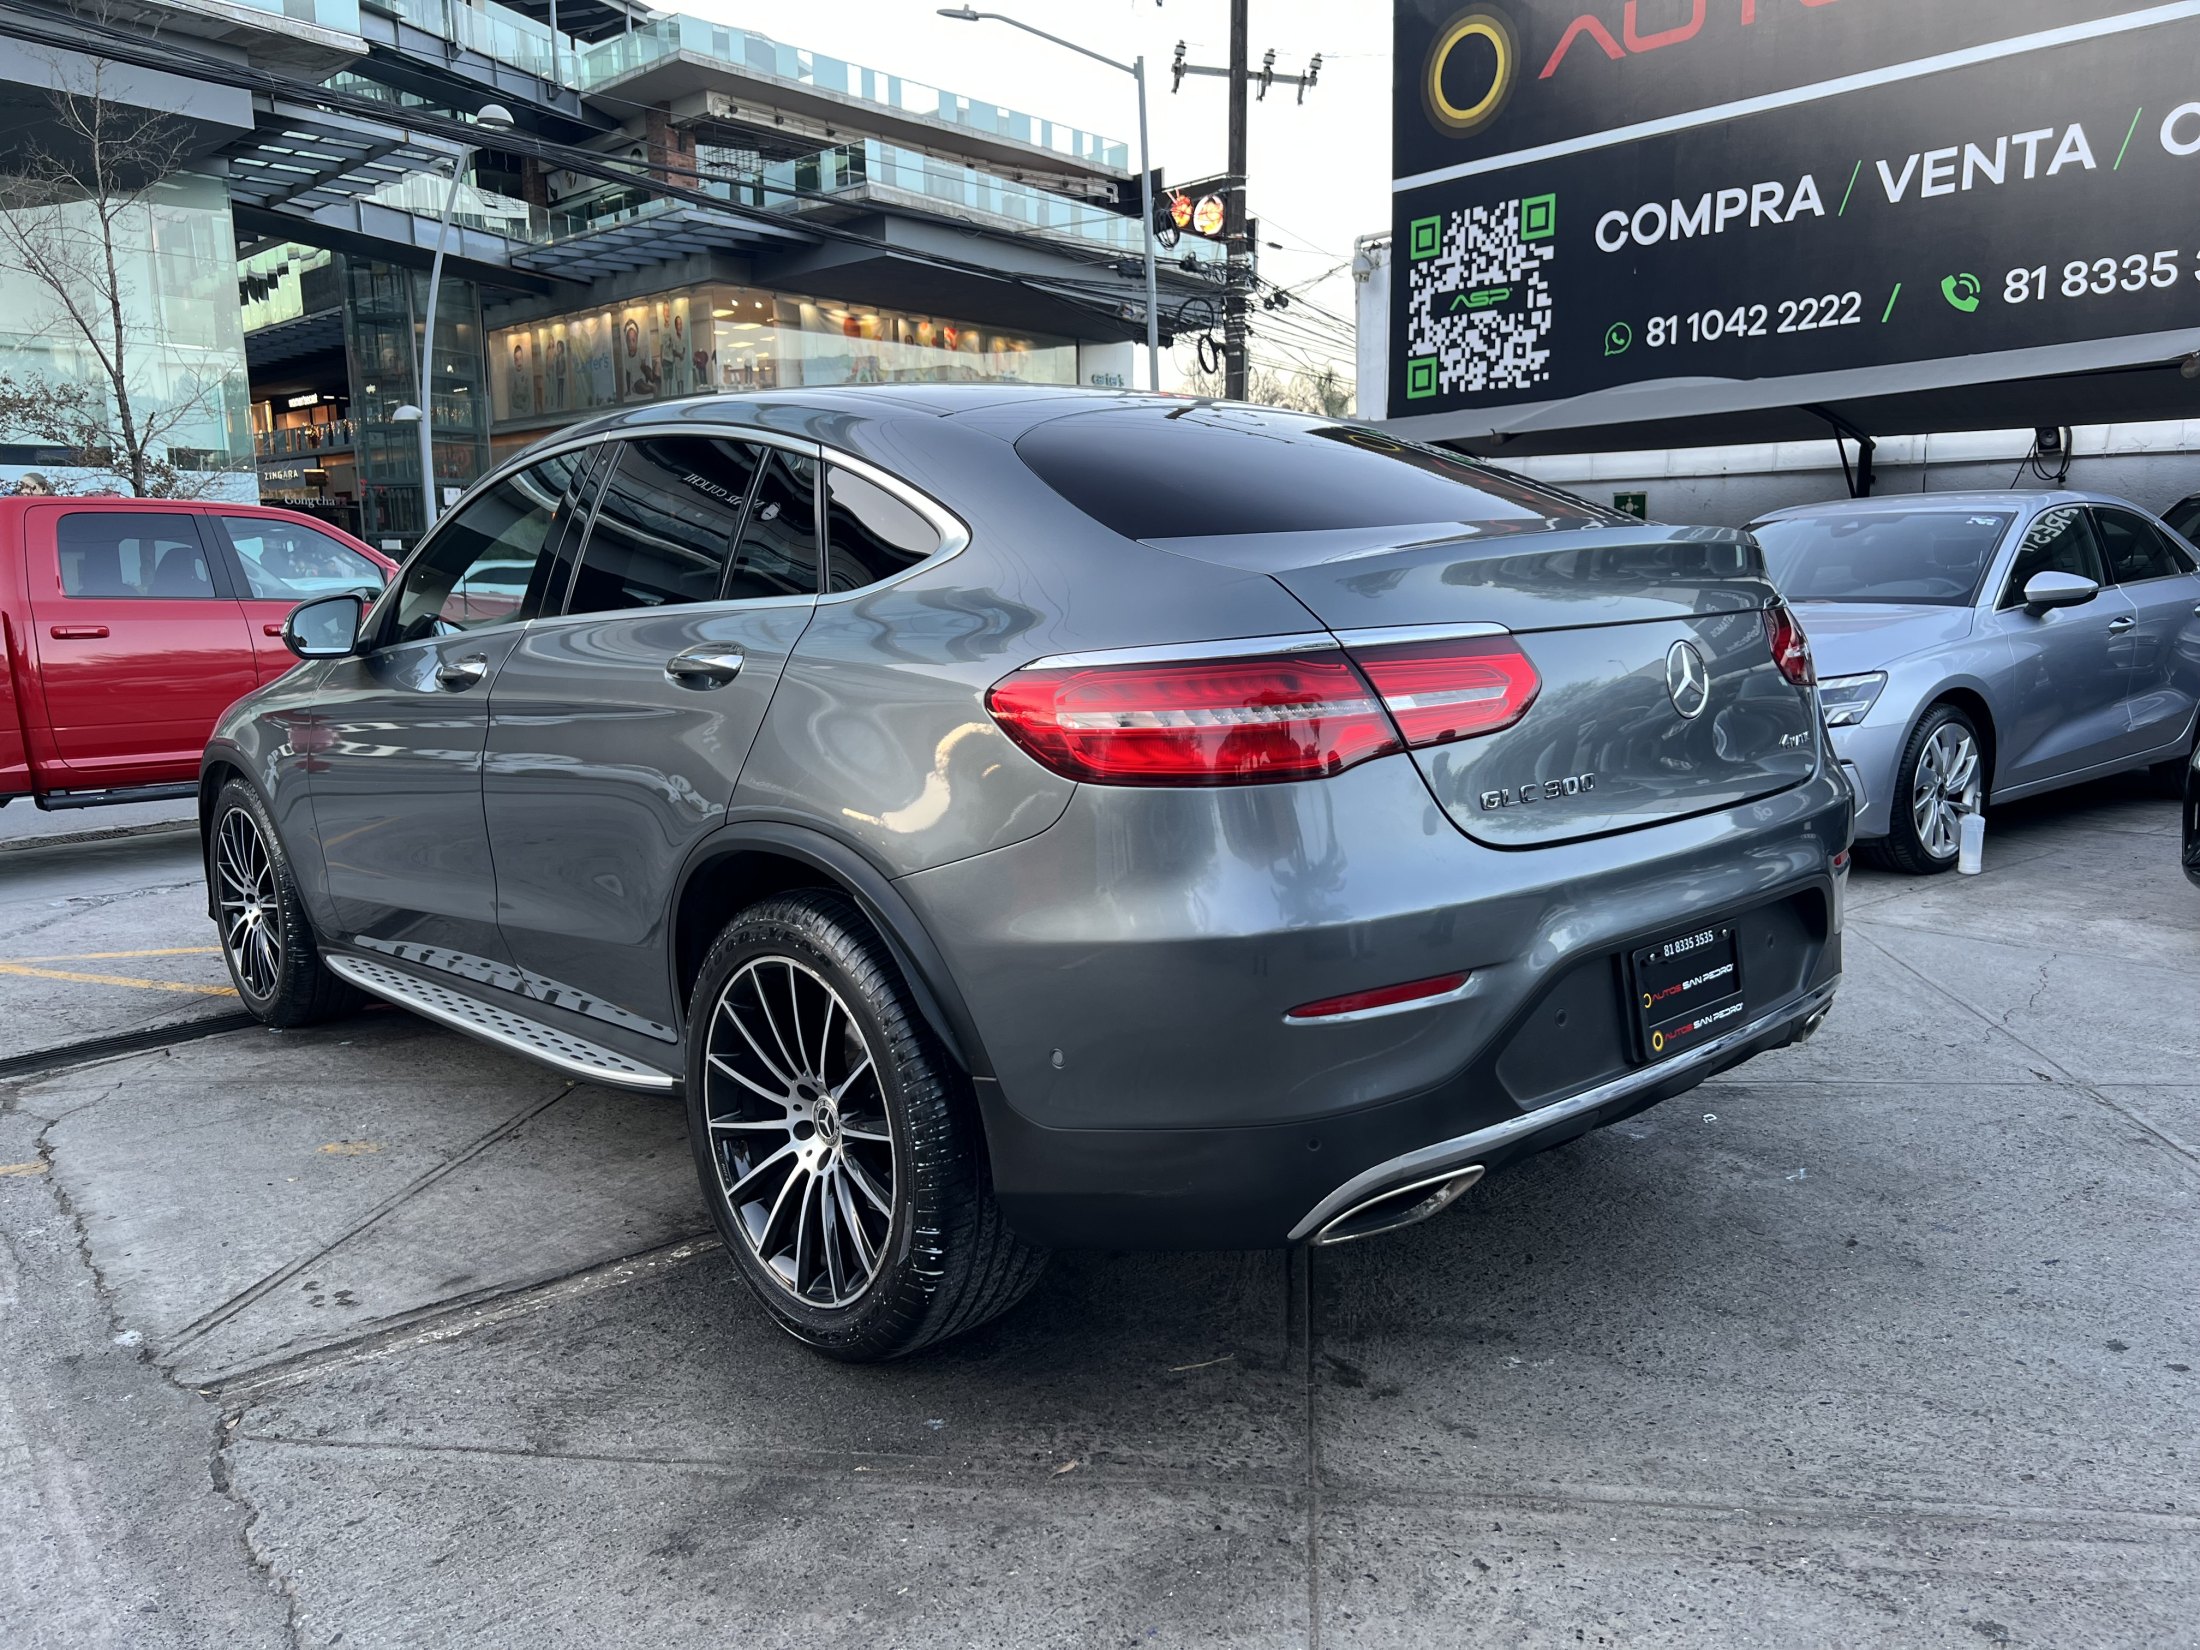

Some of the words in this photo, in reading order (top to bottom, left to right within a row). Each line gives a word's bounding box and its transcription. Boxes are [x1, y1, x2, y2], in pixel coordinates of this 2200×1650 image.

[1595, 174, 1825, 253] COMPRA
[1875, 122, 2097, 204] VENTA
[2003, 265, 2047, 304] 81
[2061, 249, 2179, 297] 8335
[1645, 315, 1678, 347] 81
[1686, 304, 1768, 343] 1042
[1776, 291, 1862, 333] 2222
[264, 469, 299, 481] ZINGARA
[284, 494, 314, 509] Gong
[316, 495, 336, 507] cha
[1480, 784, 1539, 811] GLC
[1543, 772, 1597, 800] 300
[1663, 943, 1675, 957] 81
[1675, 937, 1694, 953] 8335
[1695, 930, 1714, 947] 3535
[1652, 984, 1682, 1001] AUTOS
[1682, 976, 1703, 990] SAN
[1703, 963, 1734, 982] PEDRO
[1665, 1023, 1694, 1041] AUTOS
[1693, 1015, 1713, 1029] SAN
[1713, 1002, 1743, 1021] PEDRO
